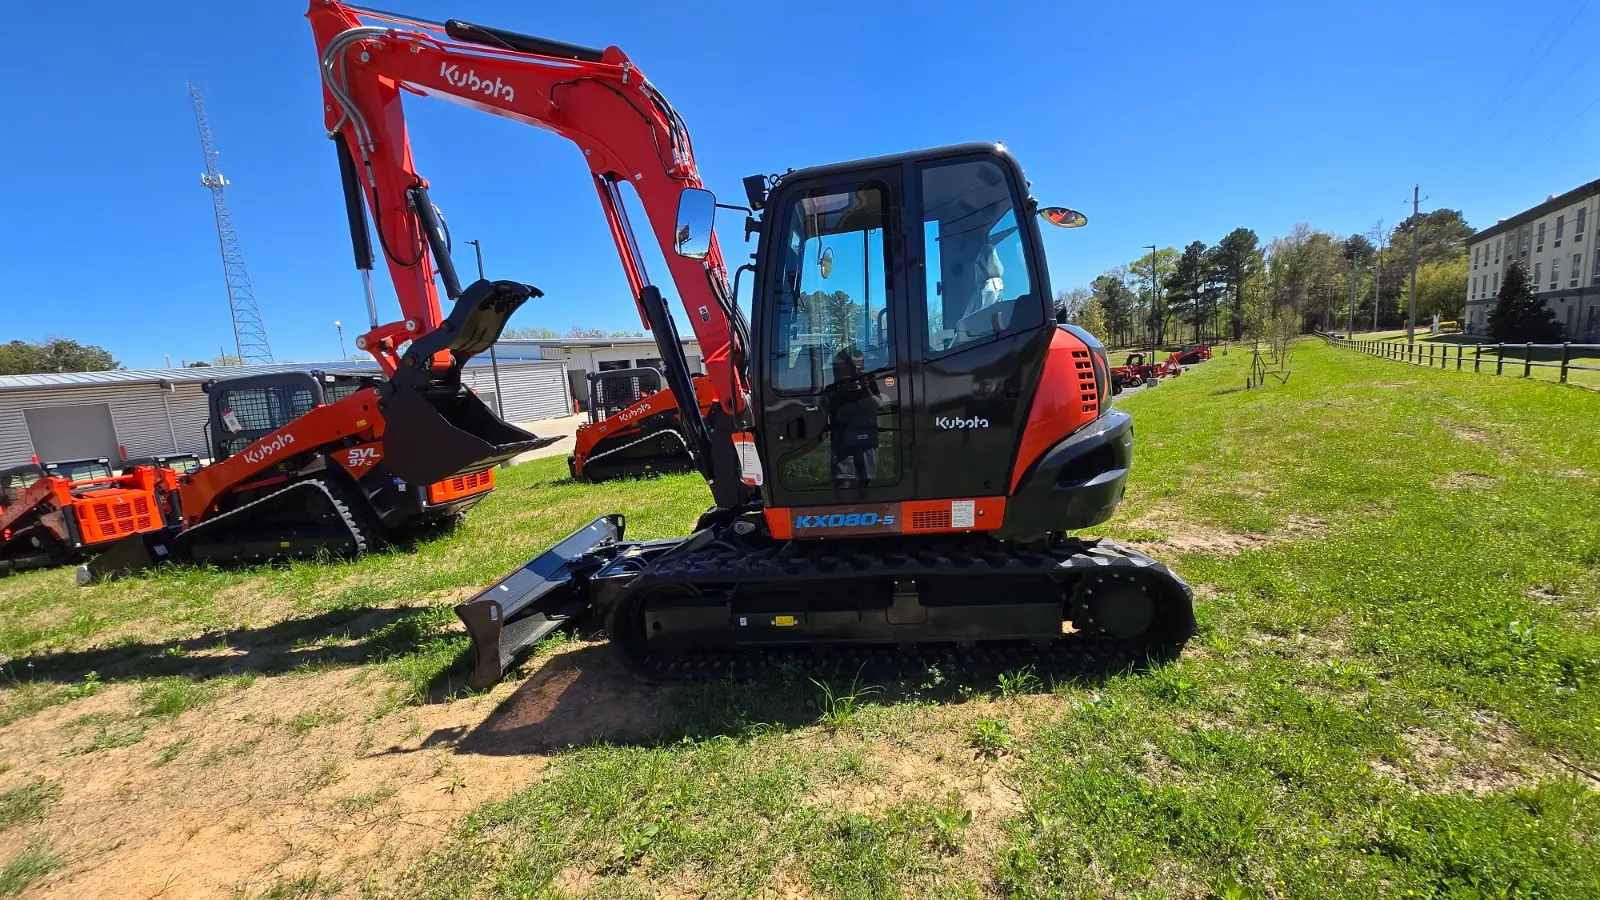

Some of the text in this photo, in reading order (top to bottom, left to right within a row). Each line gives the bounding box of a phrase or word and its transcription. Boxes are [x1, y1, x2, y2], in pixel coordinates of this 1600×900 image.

[440, 61, 514, 102] Kubota
[619, 403, 651, 421] Kubota
[935, 415, 989, 429] Kubota
[243, 432, 295, 464] Kubota
[348, 447, 380, 459] SVL
[796, 512, 895, 529] KX080-5
